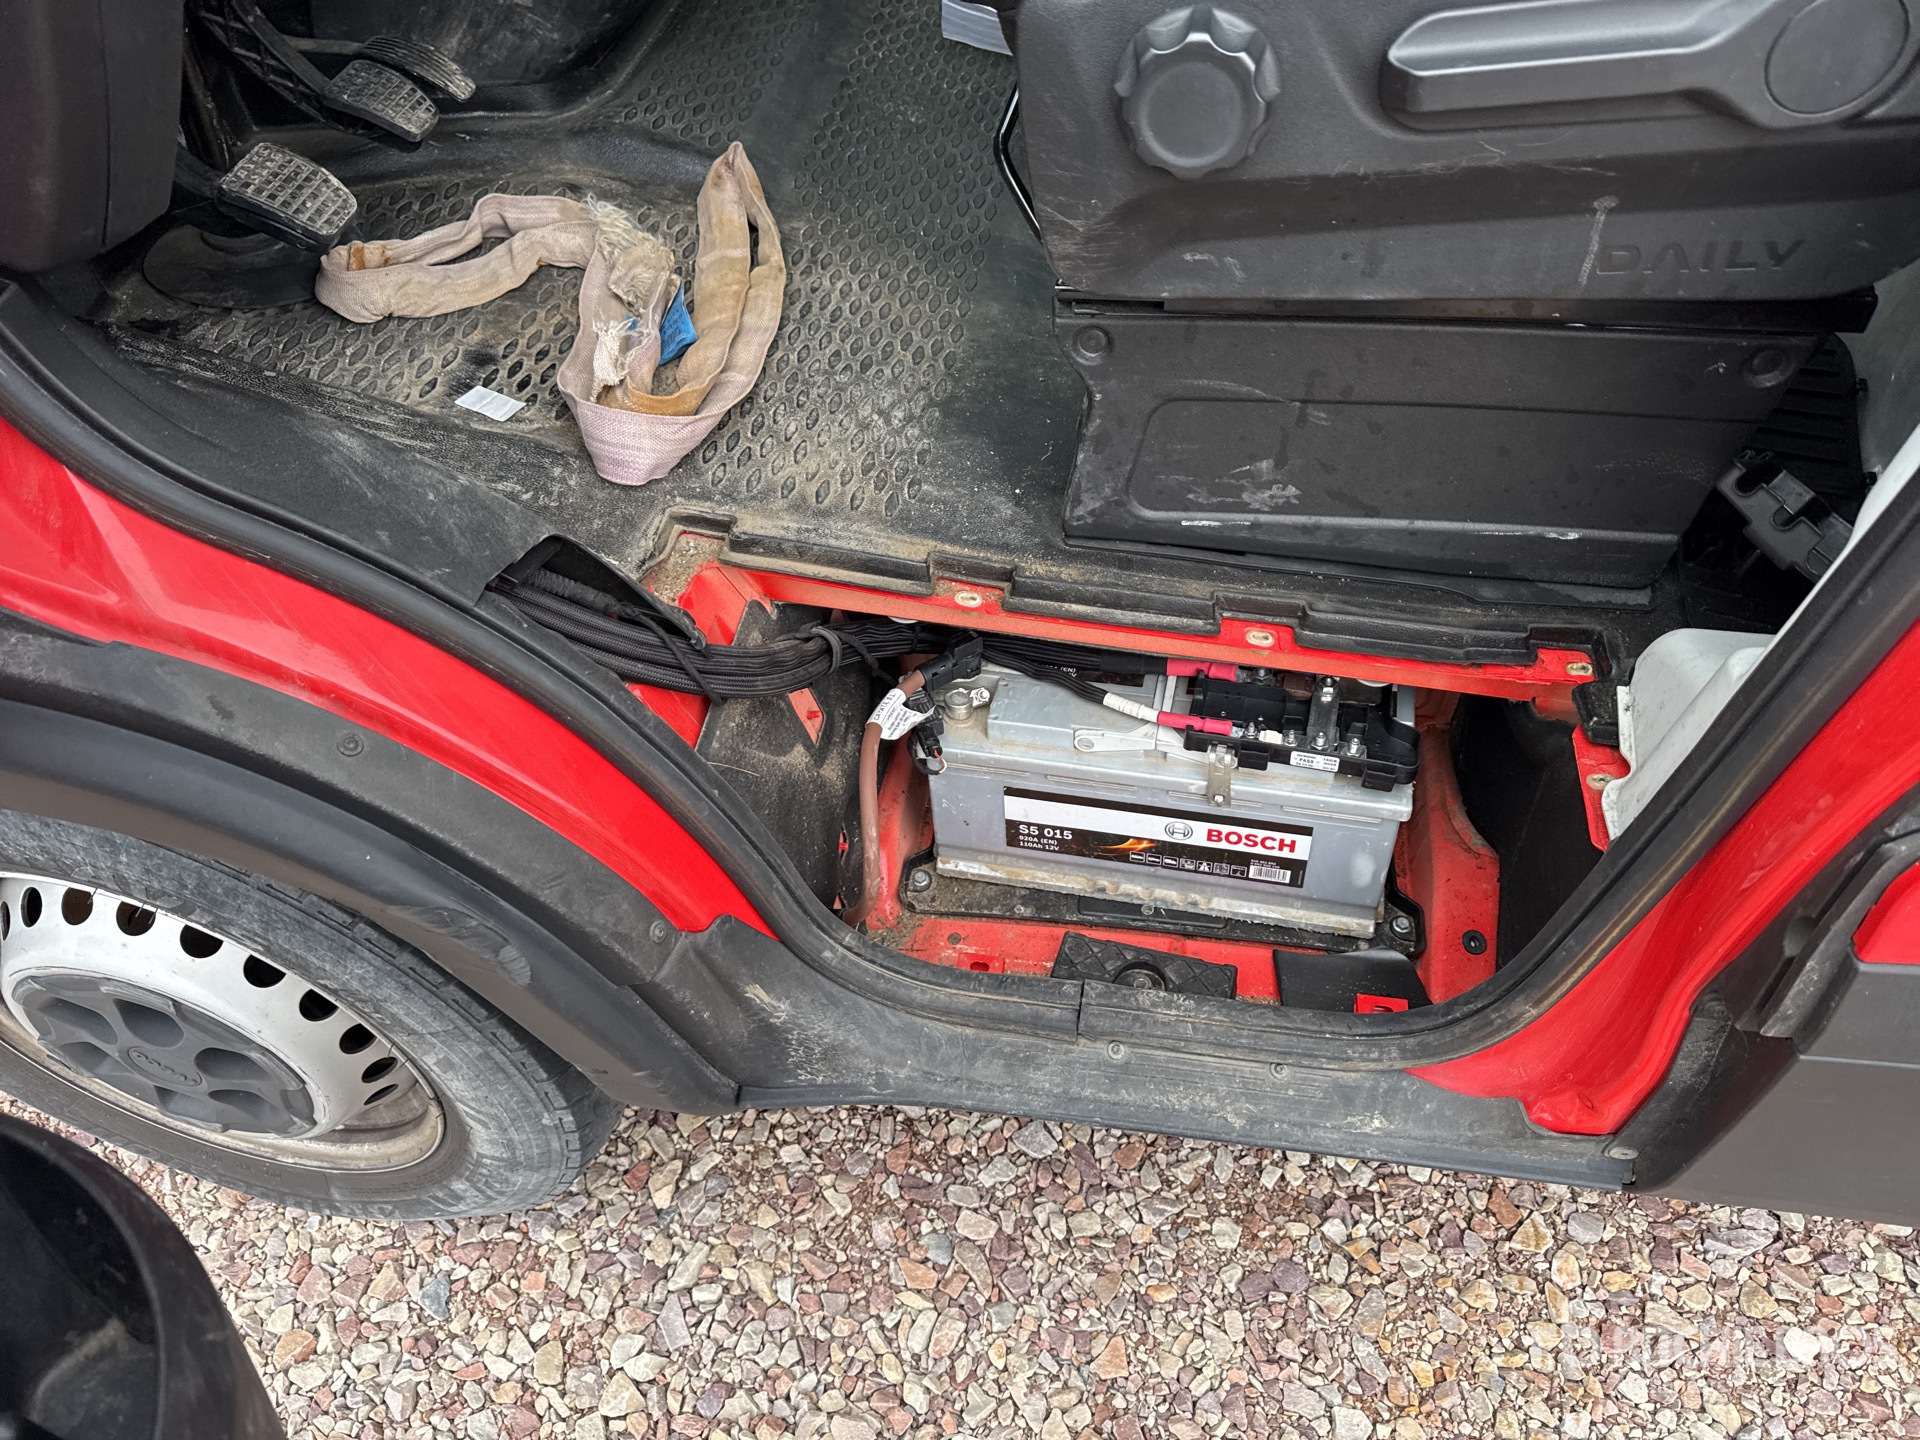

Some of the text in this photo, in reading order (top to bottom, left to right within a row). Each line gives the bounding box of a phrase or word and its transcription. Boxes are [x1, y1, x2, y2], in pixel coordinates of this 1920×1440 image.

[1596, 238, 1805, 275] DAILY
[1018, 824, 1073, 840] S5 015
[1019, 834, 1058, 846] 920A (EN)
[1019, 840, 1043, 849] 110Ah
[1206, 828, 1297, 853] BOSCH
